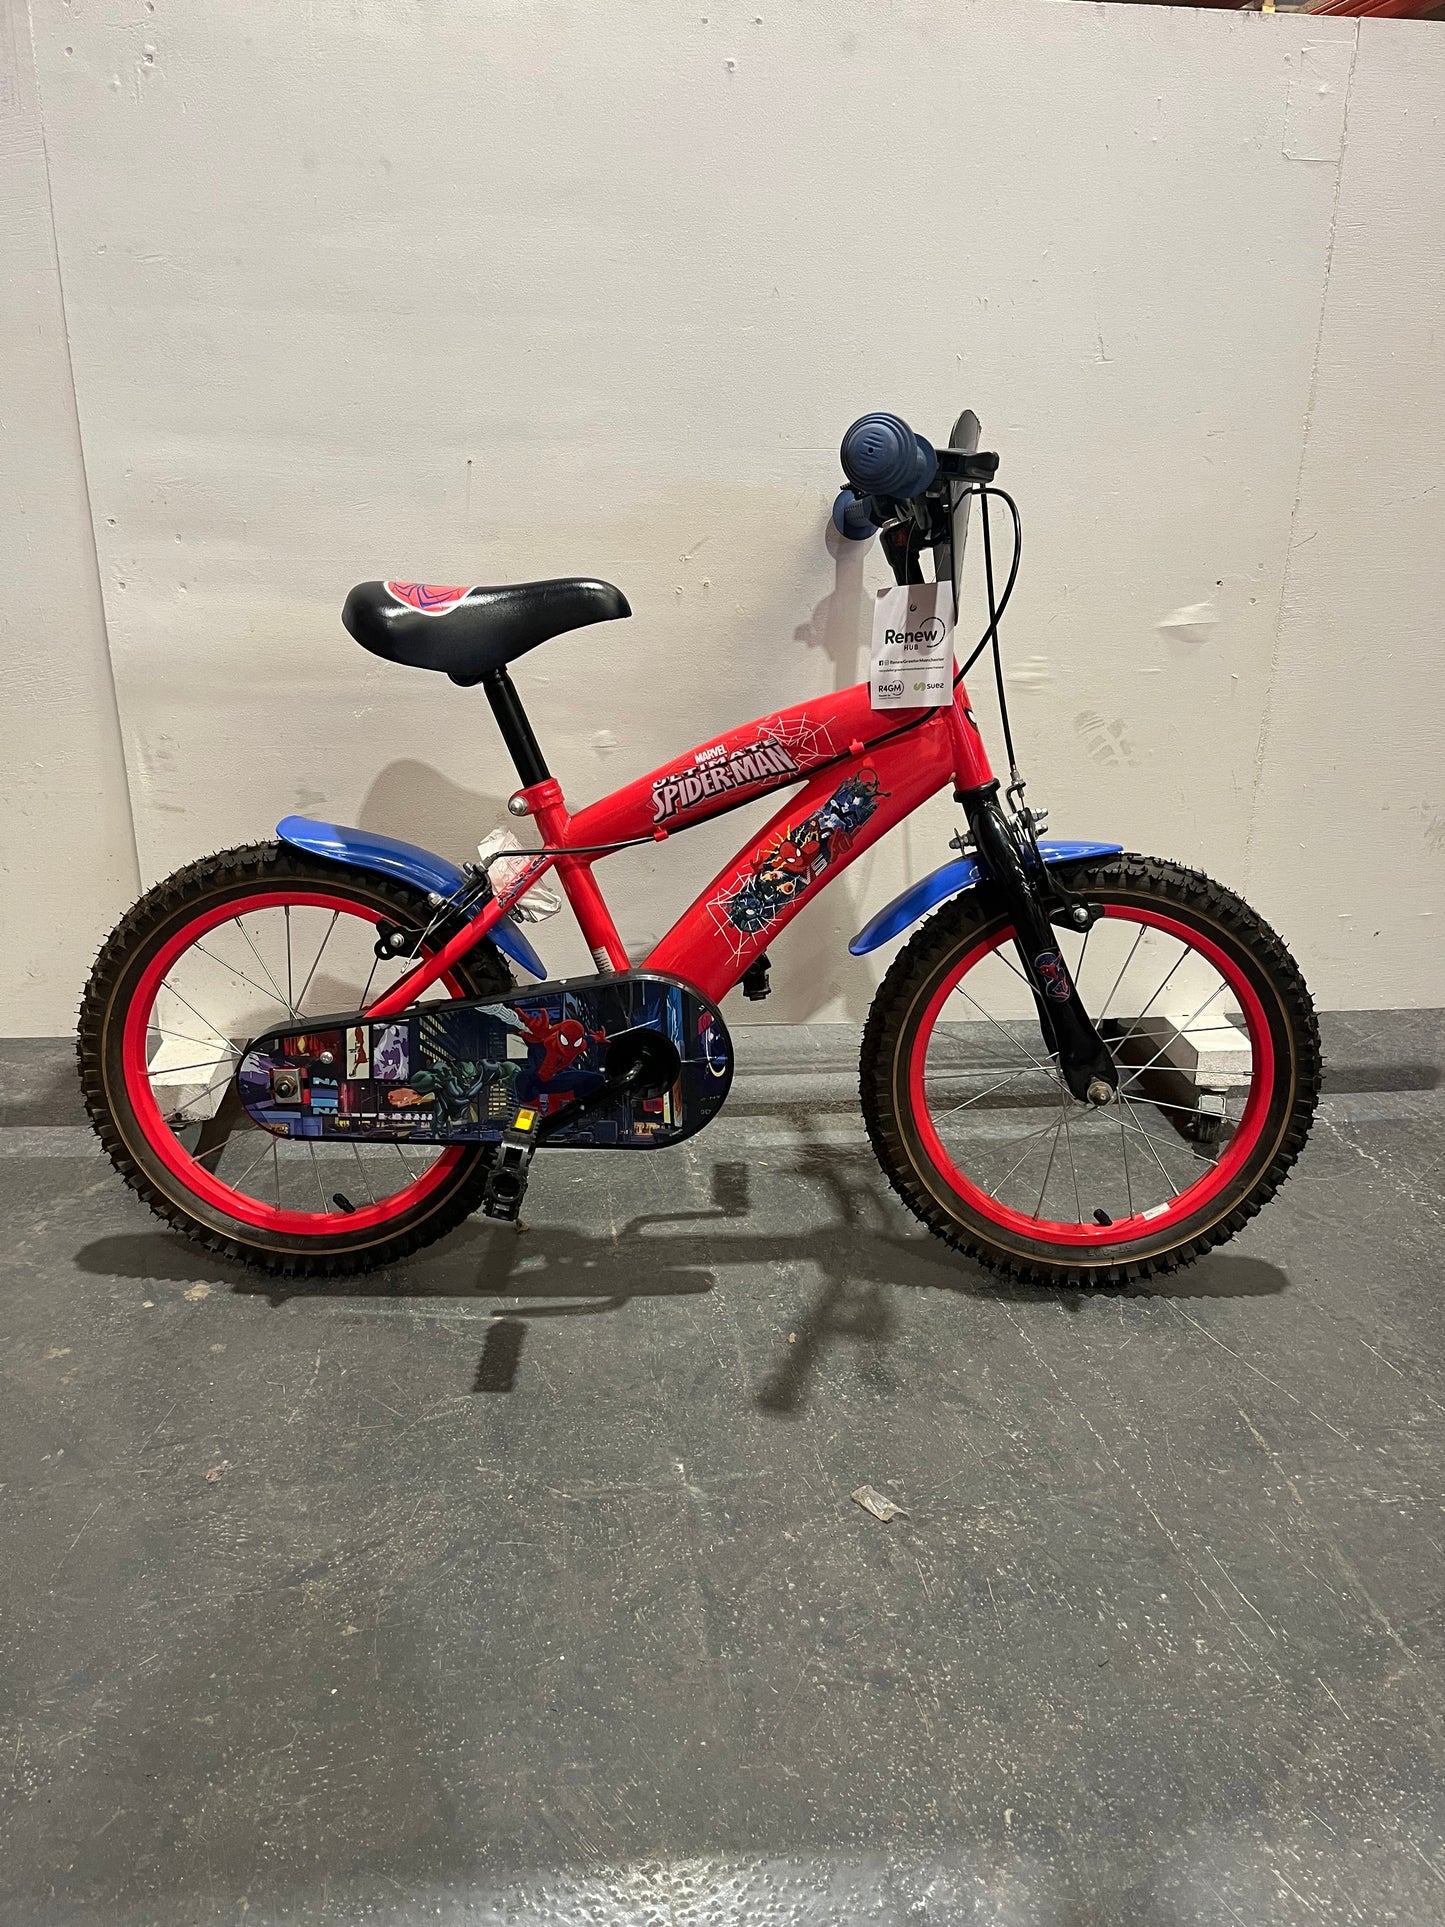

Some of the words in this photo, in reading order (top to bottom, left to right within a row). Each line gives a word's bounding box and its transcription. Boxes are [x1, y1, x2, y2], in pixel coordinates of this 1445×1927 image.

[885, 629, 938, 645] Renew
[878, 683, 902, 692] R4GM
[926, 682, 945, 690] suez
[694, 744, 728, 764] MARVEL
[652, 737, 780, 790] ULTIMATE
[651, 745, 798, 823] SPIDER-MAN
